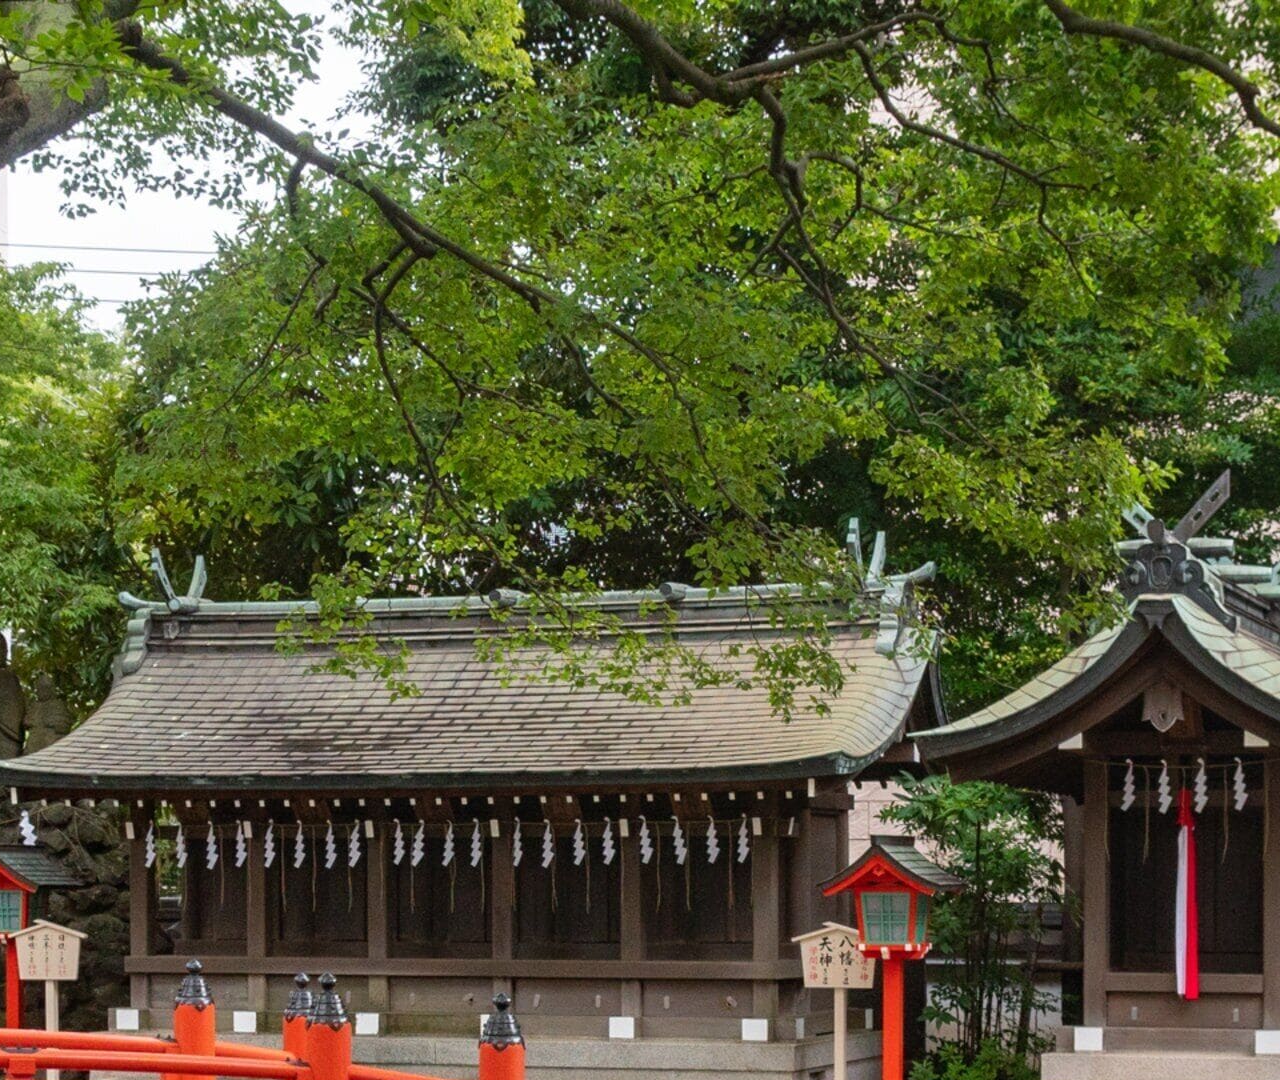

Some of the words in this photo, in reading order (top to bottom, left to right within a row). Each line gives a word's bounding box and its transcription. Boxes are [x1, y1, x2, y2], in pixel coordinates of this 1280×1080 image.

[819, 936, 833, 985] 天神さま
[838, 935, 856, 985] 八幡さま
